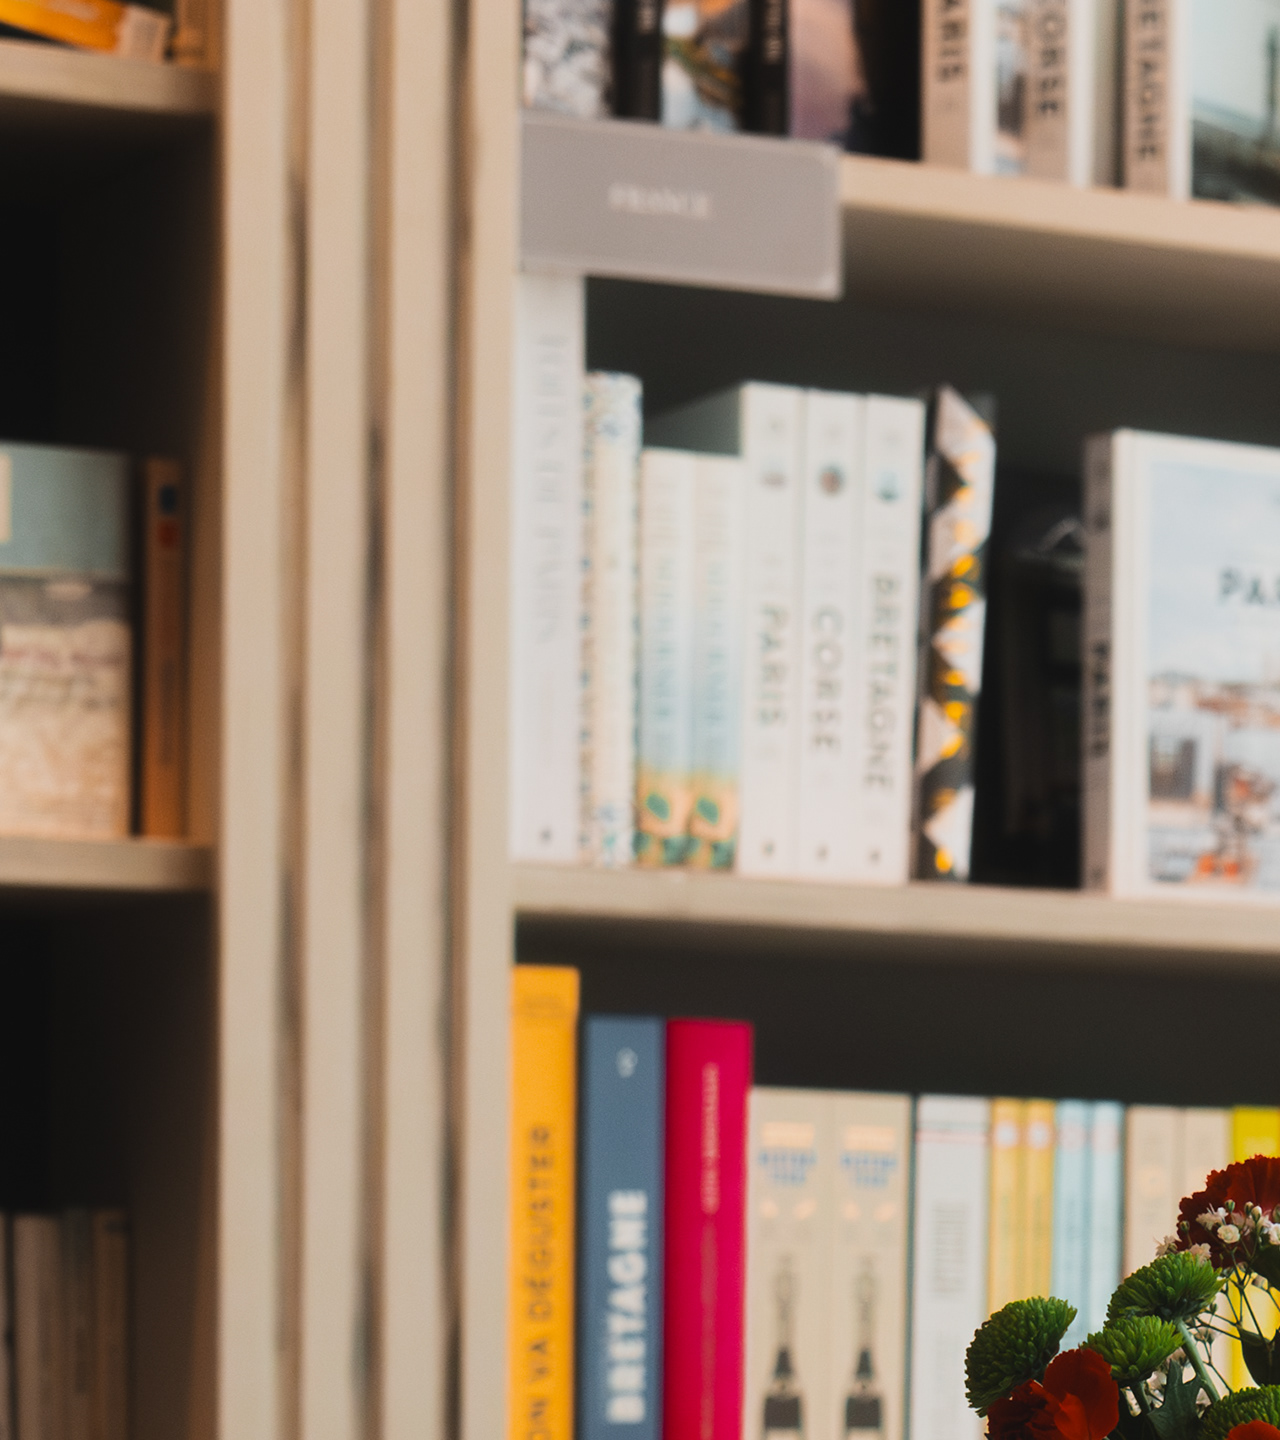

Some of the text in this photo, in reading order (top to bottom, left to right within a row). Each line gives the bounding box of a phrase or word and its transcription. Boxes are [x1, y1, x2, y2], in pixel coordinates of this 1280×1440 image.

[608, 181, 713, 220] FRANCE
[757, 604, 788, 727] PARIS
[811, 606, 844, 755] CORSE
[864, 573, 901, 792] BRETAGNE
[523, 1124, 552, 1320] DÉGUSTER
[525, 1335, 552, 1381] VA
[607, 1189, 648, 1425] BRETAGNE
